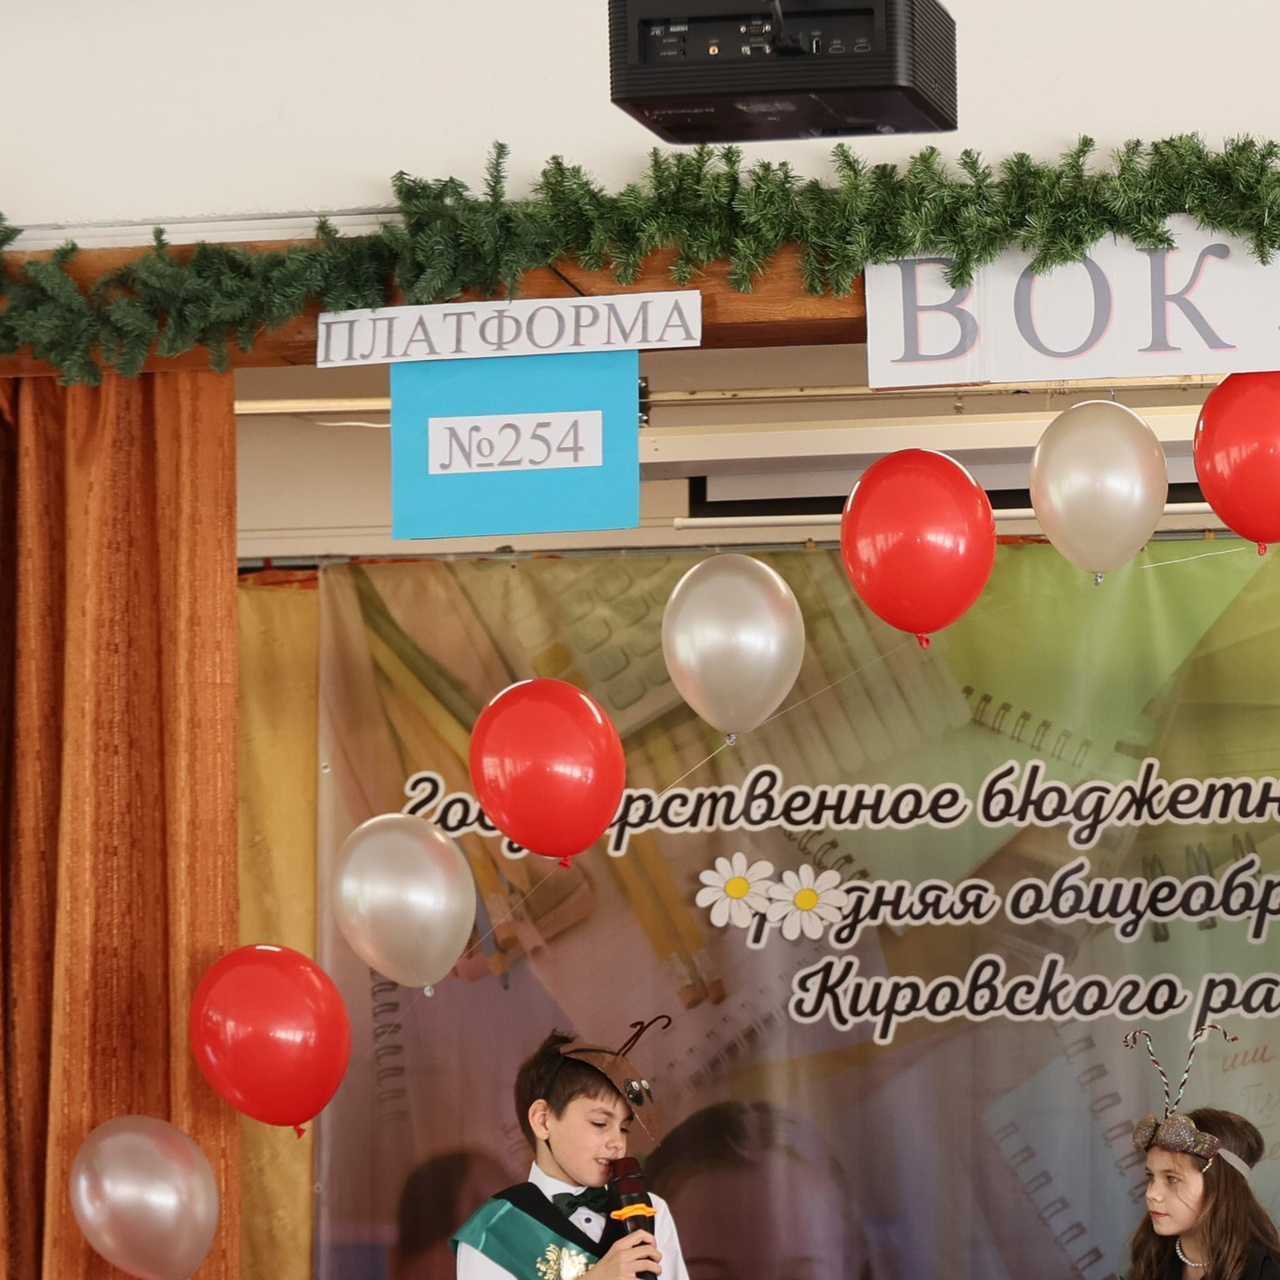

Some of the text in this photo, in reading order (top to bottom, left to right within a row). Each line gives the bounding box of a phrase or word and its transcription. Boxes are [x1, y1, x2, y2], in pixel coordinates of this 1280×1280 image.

[320, 299, 699, 364] ПЛАТФОРМА
[438, 421, 584, 470] №254
[405, 767, 964, 853] Горственное
[752, 884, 991, 944] дняя
[794, 957, 1182, 1038] Кировского
